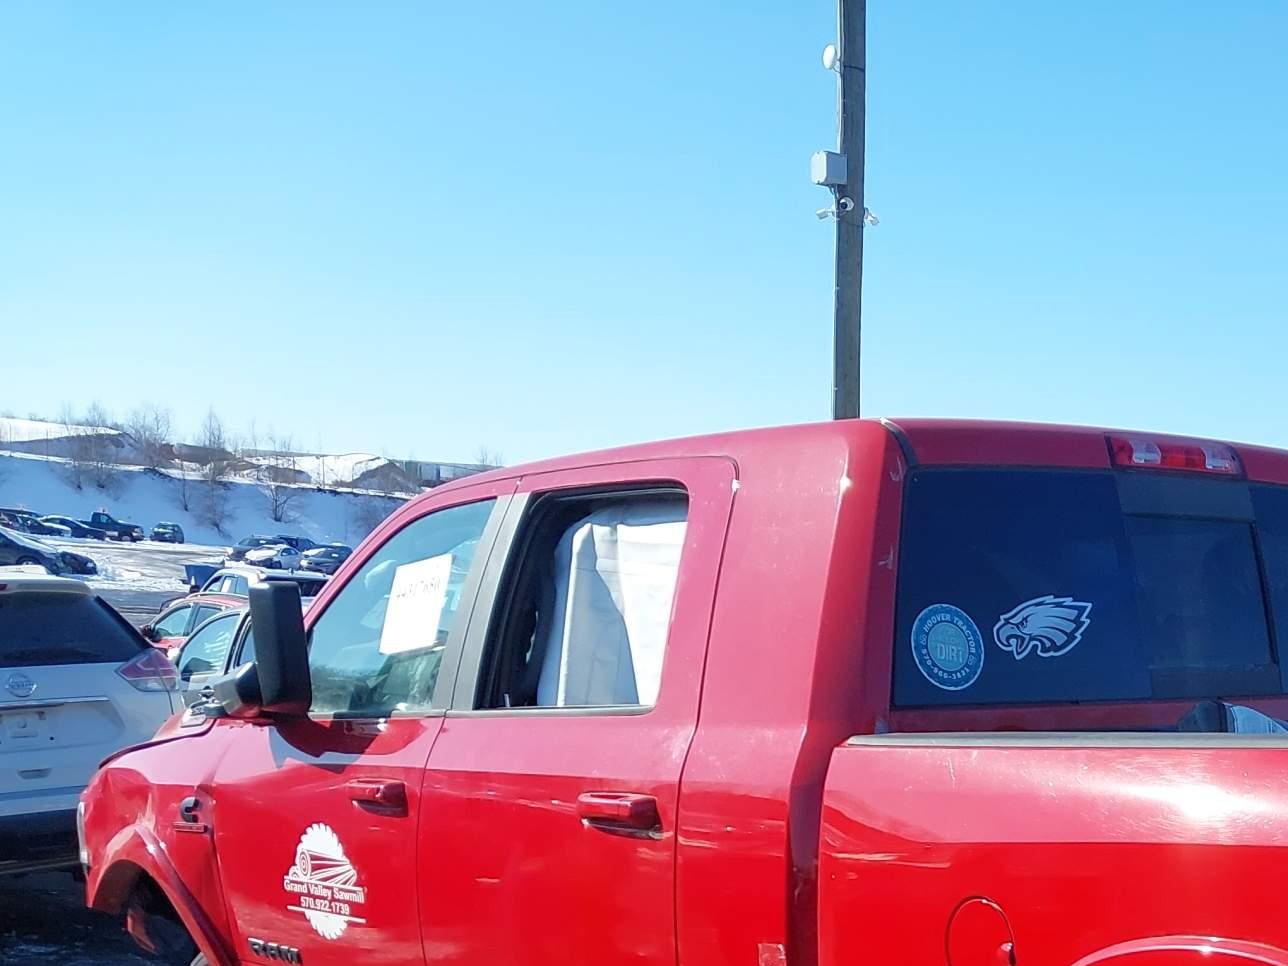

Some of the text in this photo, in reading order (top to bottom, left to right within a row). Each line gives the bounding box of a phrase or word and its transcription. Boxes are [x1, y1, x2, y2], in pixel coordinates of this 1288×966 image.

[923, 613, 951, 633] HOOVER
[953, 616, 976, 653] TRACTOR
[937, 643, 963, 663] DIRT
[283, 879, 365, 904] Grand Valley Sawmill
[300, 896, 350, 915] 570.922.1739
[248, 937, 303, 966] RAM
